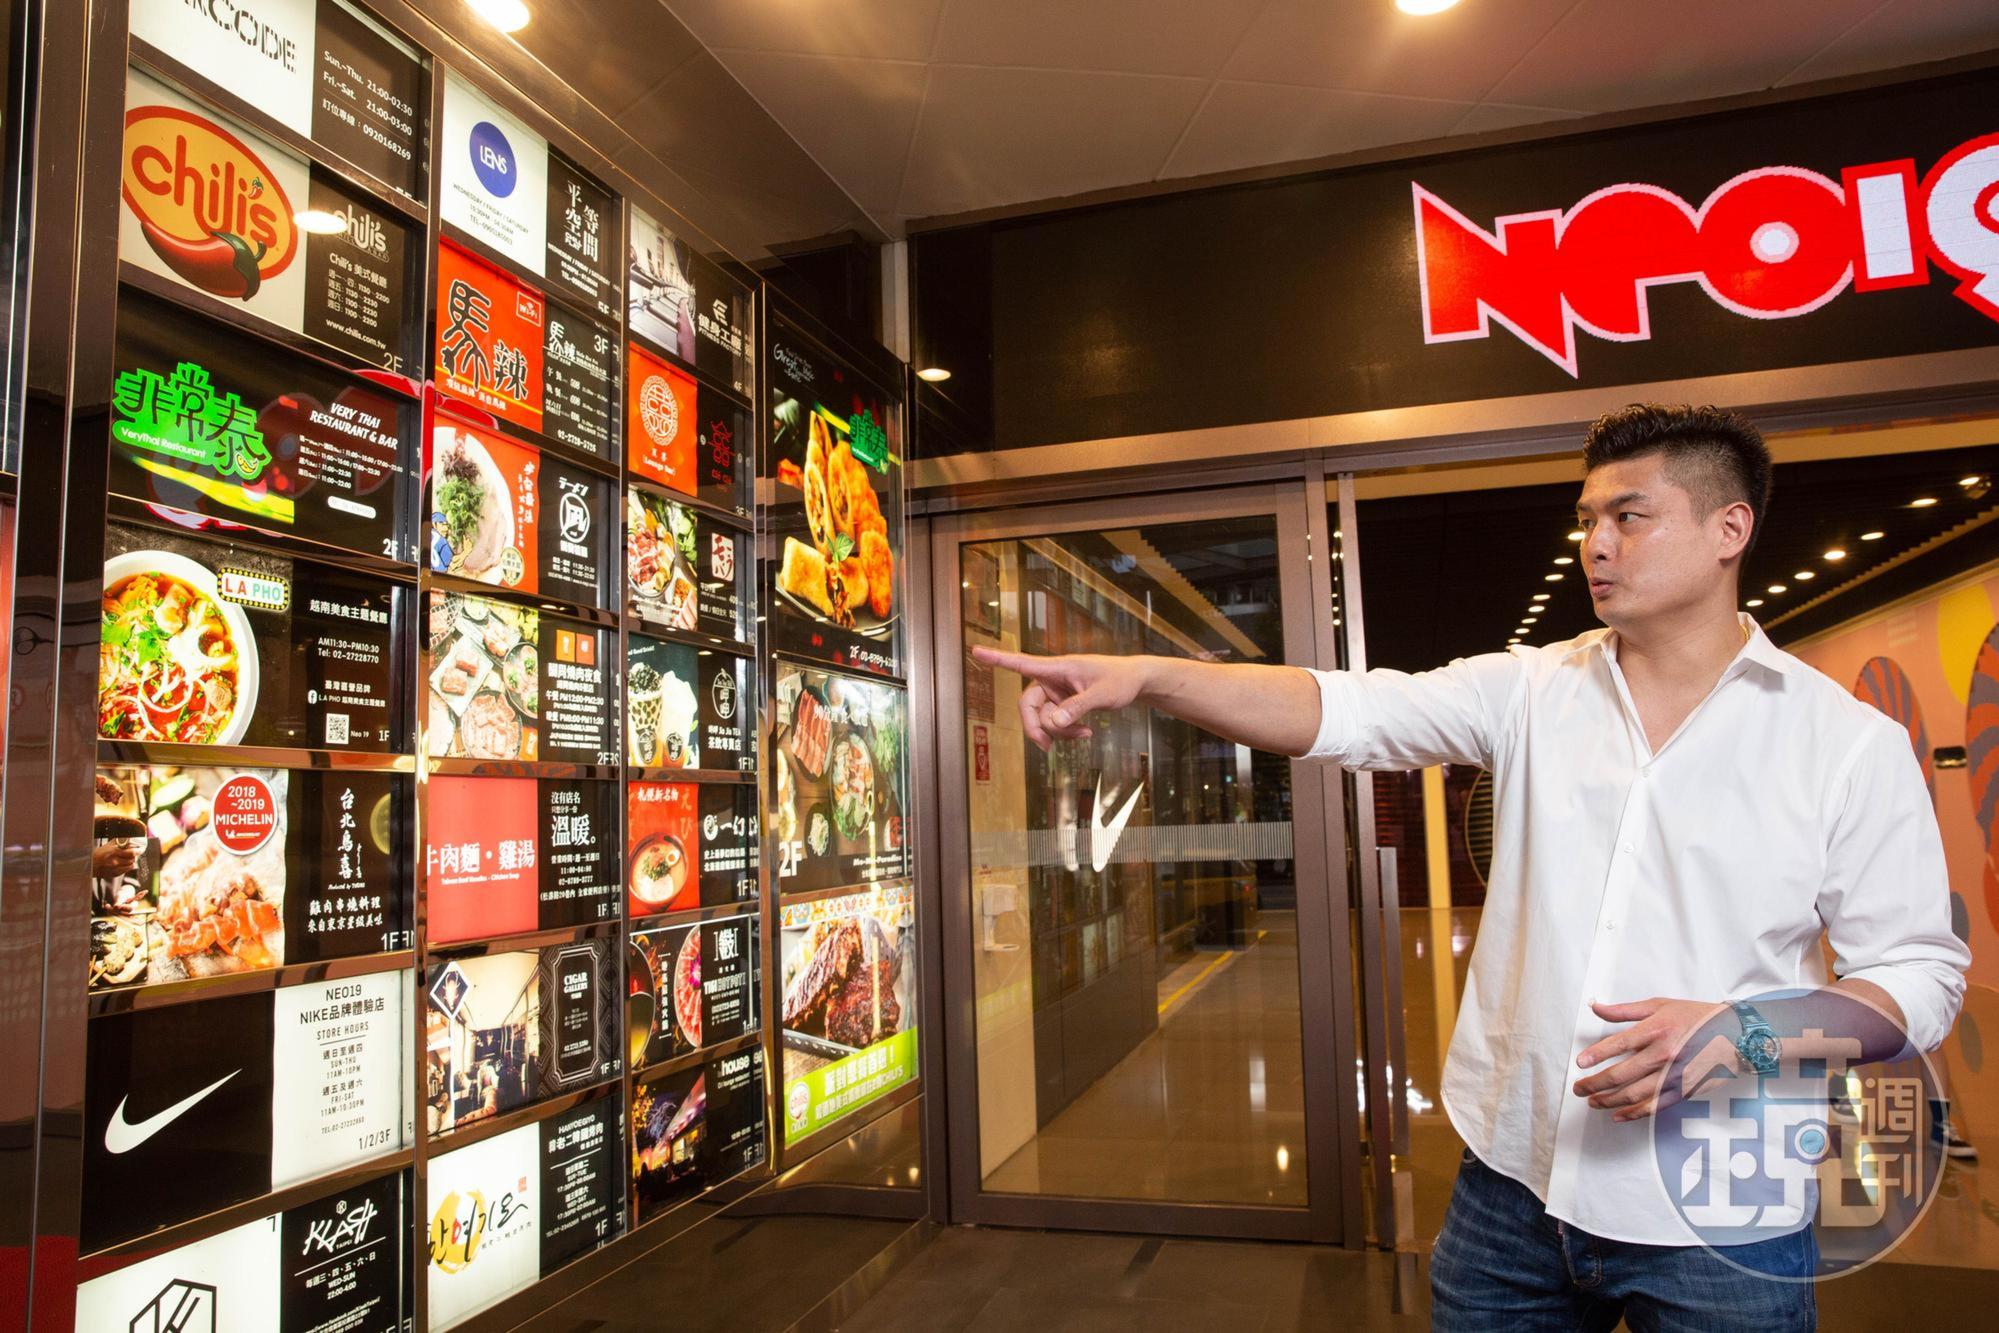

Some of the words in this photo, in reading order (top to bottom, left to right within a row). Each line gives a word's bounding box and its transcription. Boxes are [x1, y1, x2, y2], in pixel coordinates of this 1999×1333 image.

[363, 124, 411, 160] 0920168269
[480, 145, 507, 174] LENS
[330, 252, 353, 273] Chili's
[326, 319, 386, 350] www.chilis.com.tw
[594, 334, 608, 355] 3F
[383, 352, 404, 374] 2F
[113, 362, 272, 480] 非常泰
[330, 403, 358, 420] VERY
[359, 413, 381, 429] THAI
[309, 410, 371, 440] RESTAURANT
[377, 434, 399, 450] BAR
[252, 583, 282, 602] PHO
[310, 599, 389, 624] 越南美食主題餐廳
[317, 647, 331, 659] Tel:
[332, 649, 380, 664] 02-27228770
[318, 637, 380, 654] AM11:30-PM10:30
[378, 729, 390, 743] 1F
[597, 752, 609, 765] 2F
[227, 786, 256, 798] 2018
[551, 791, 581, 805] 沒有店名
[215, 813, 273, 826] MICHELIN
[778, 841, 802, 877] 2F
[381, 931, 399, 951] 1F
[564, 972, 588, 986] CIGAR
[325, 984, 362, 1001] NEO19
[300, 997, 385, 1025] NIKE品牌體驗店
[317, 1026, 341, 1041] STORE
[344, 1021, 369, 1036] HOURS
[326, 1065, 361, 1079] 11AM-10PM
[331, 1056, 357, 1069] SUN-THU
[720, 1054, 750, 1078] house
[331, 1092, 354, 1104] FRI-SAT
[358, 1128, 391, 1151] 1/2/3F
[595, 1218, 608, 1237] 1F
[328, 1272, 356, 1289] WED-SUN
